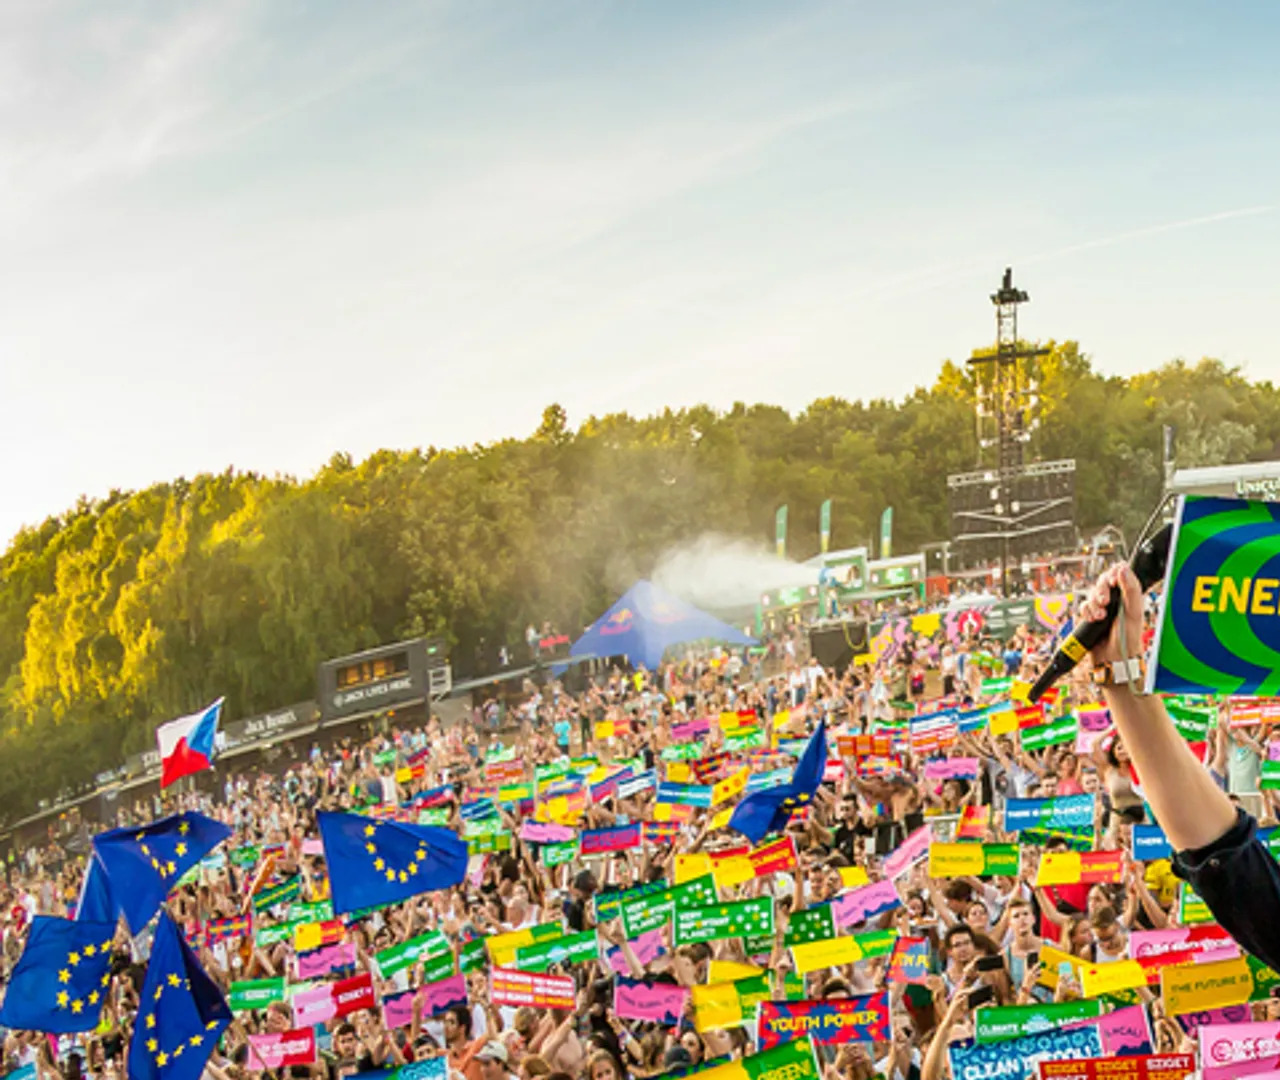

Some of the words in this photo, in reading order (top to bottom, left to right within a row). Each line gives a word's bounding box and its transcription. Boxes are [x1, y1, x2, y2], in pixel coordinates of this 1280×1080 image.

[769, 1015, 820, 1034] YOUTH
[823, 1009, 879, 1030] POWER
[964, 1058, 1020, 1080] CLEAN
